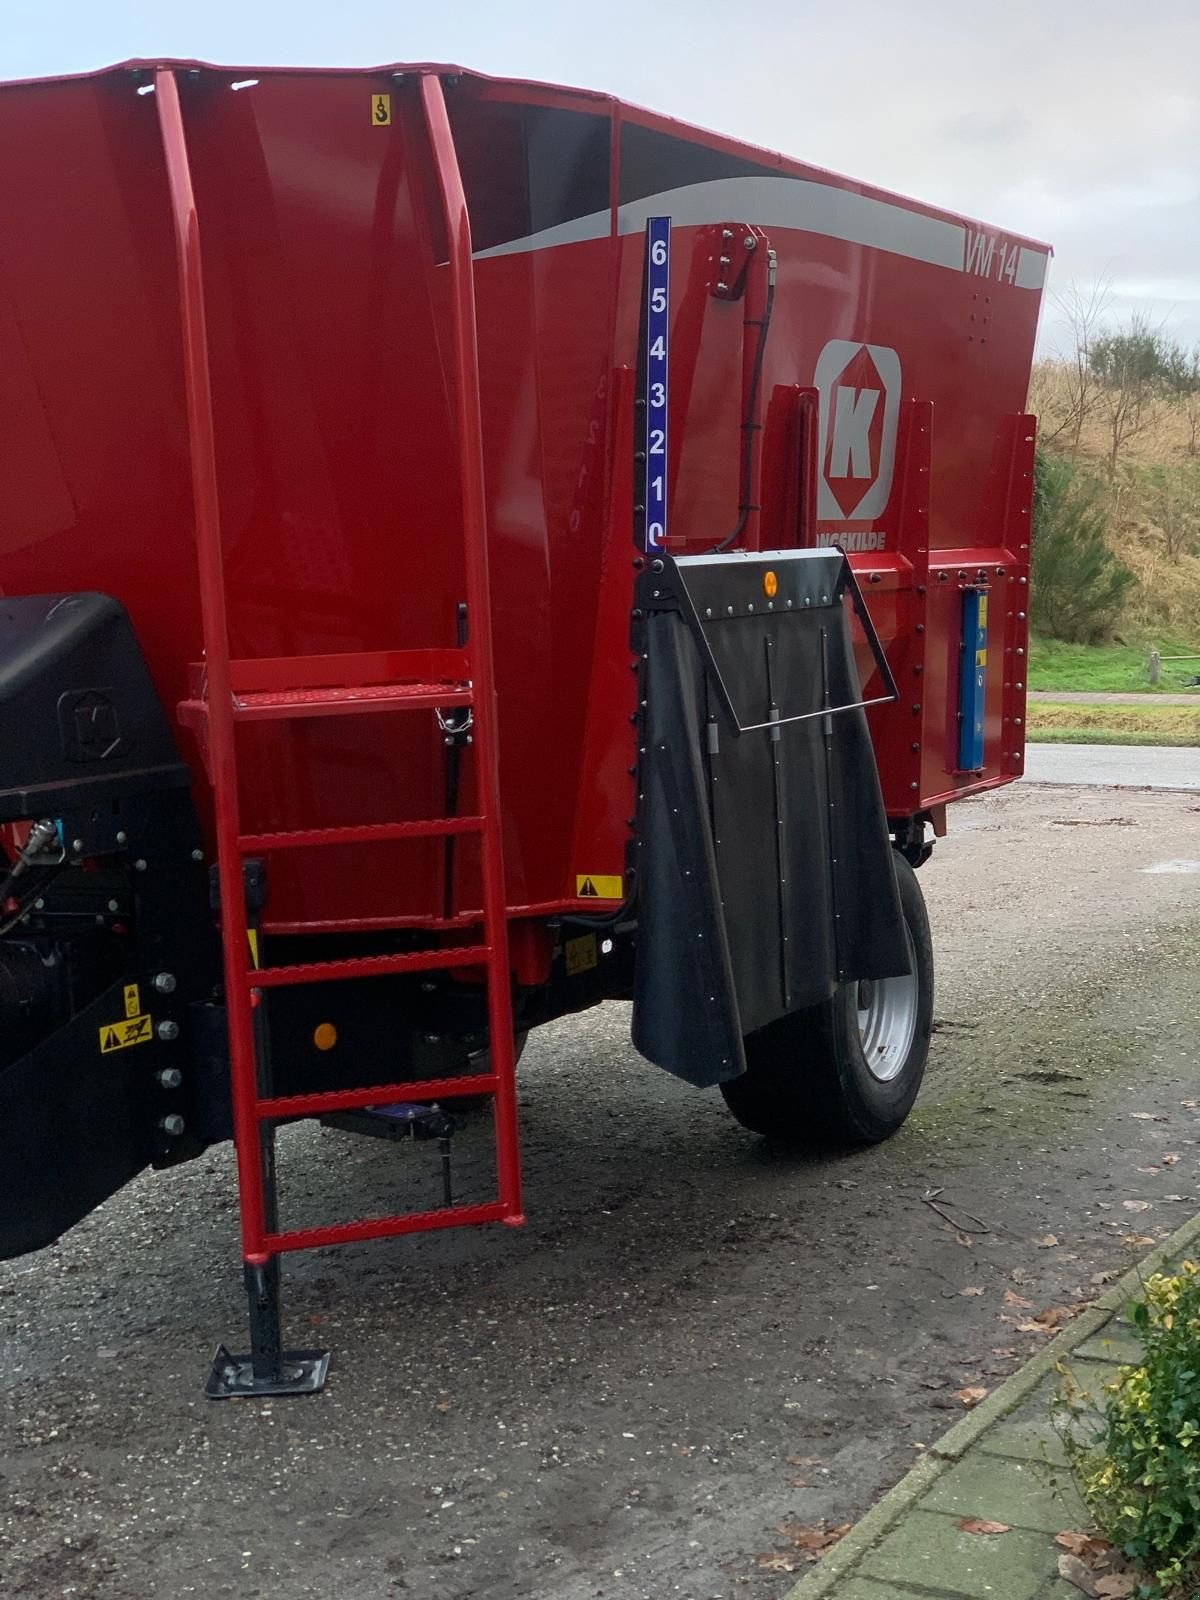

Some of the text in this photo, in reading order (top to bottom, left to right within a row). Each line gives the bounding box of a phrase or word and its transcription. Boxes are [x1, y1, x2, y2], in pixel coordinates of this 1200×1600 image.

[652, 240, 666, 265] 6
[966, 229, 1018, 285] VM 14
[652, 288, 666, 312] 5
[650, 336, 665, 360] 4
[651, 383, 665, 407] 3
[649, 430, 665, 454] 2
[829, 385, 880, 479] K
[651, 476, 662, 501] 1
[649, 522, 663, 546] 0
[816, 532, 886, 552] NGSKILDE
